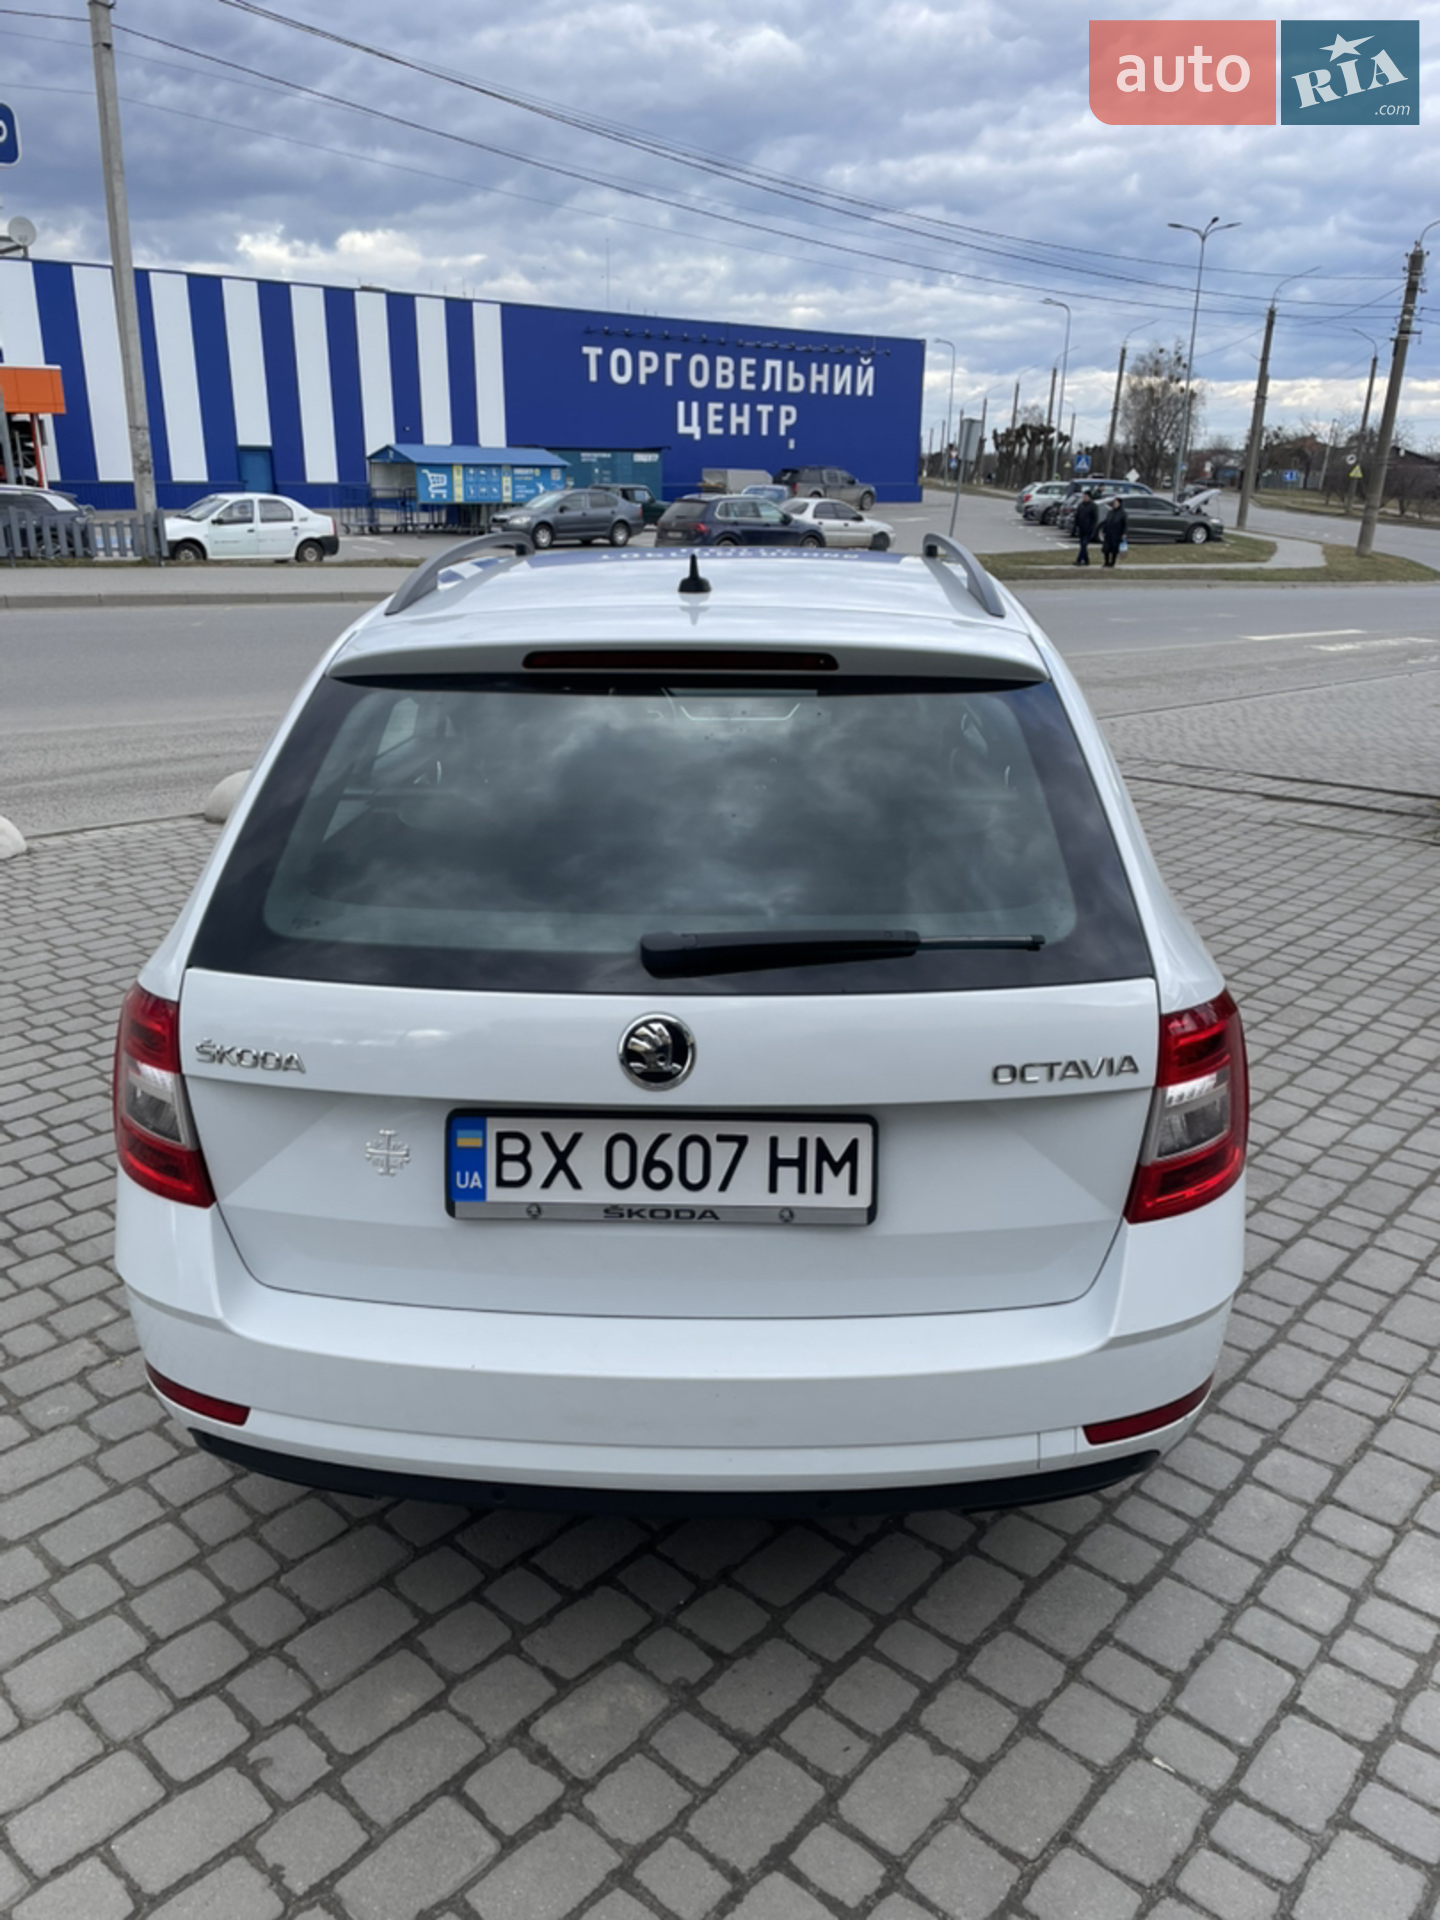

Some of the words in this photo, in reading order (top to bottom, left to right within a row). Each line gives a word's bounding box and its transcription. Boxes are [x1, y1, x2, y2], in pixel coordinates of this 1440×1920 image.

[582, 345, 875, 397] ТОРГОВЕЛЬНИЙ
[676, 400, 798, 441] ЦЕНТР
[195, 1037, 306, 1074] ŠKODA
[992, 1055, 1140, 1085] OCTAVIA
[456, 1171, 483, 1189] UA
[495, 1130, 584, 1190] BX
[604, 1131, 749, 1193] 0607
[768, 1135, 859, 1196] HM
[603, 1204, 721, 1221] ŠKODA
